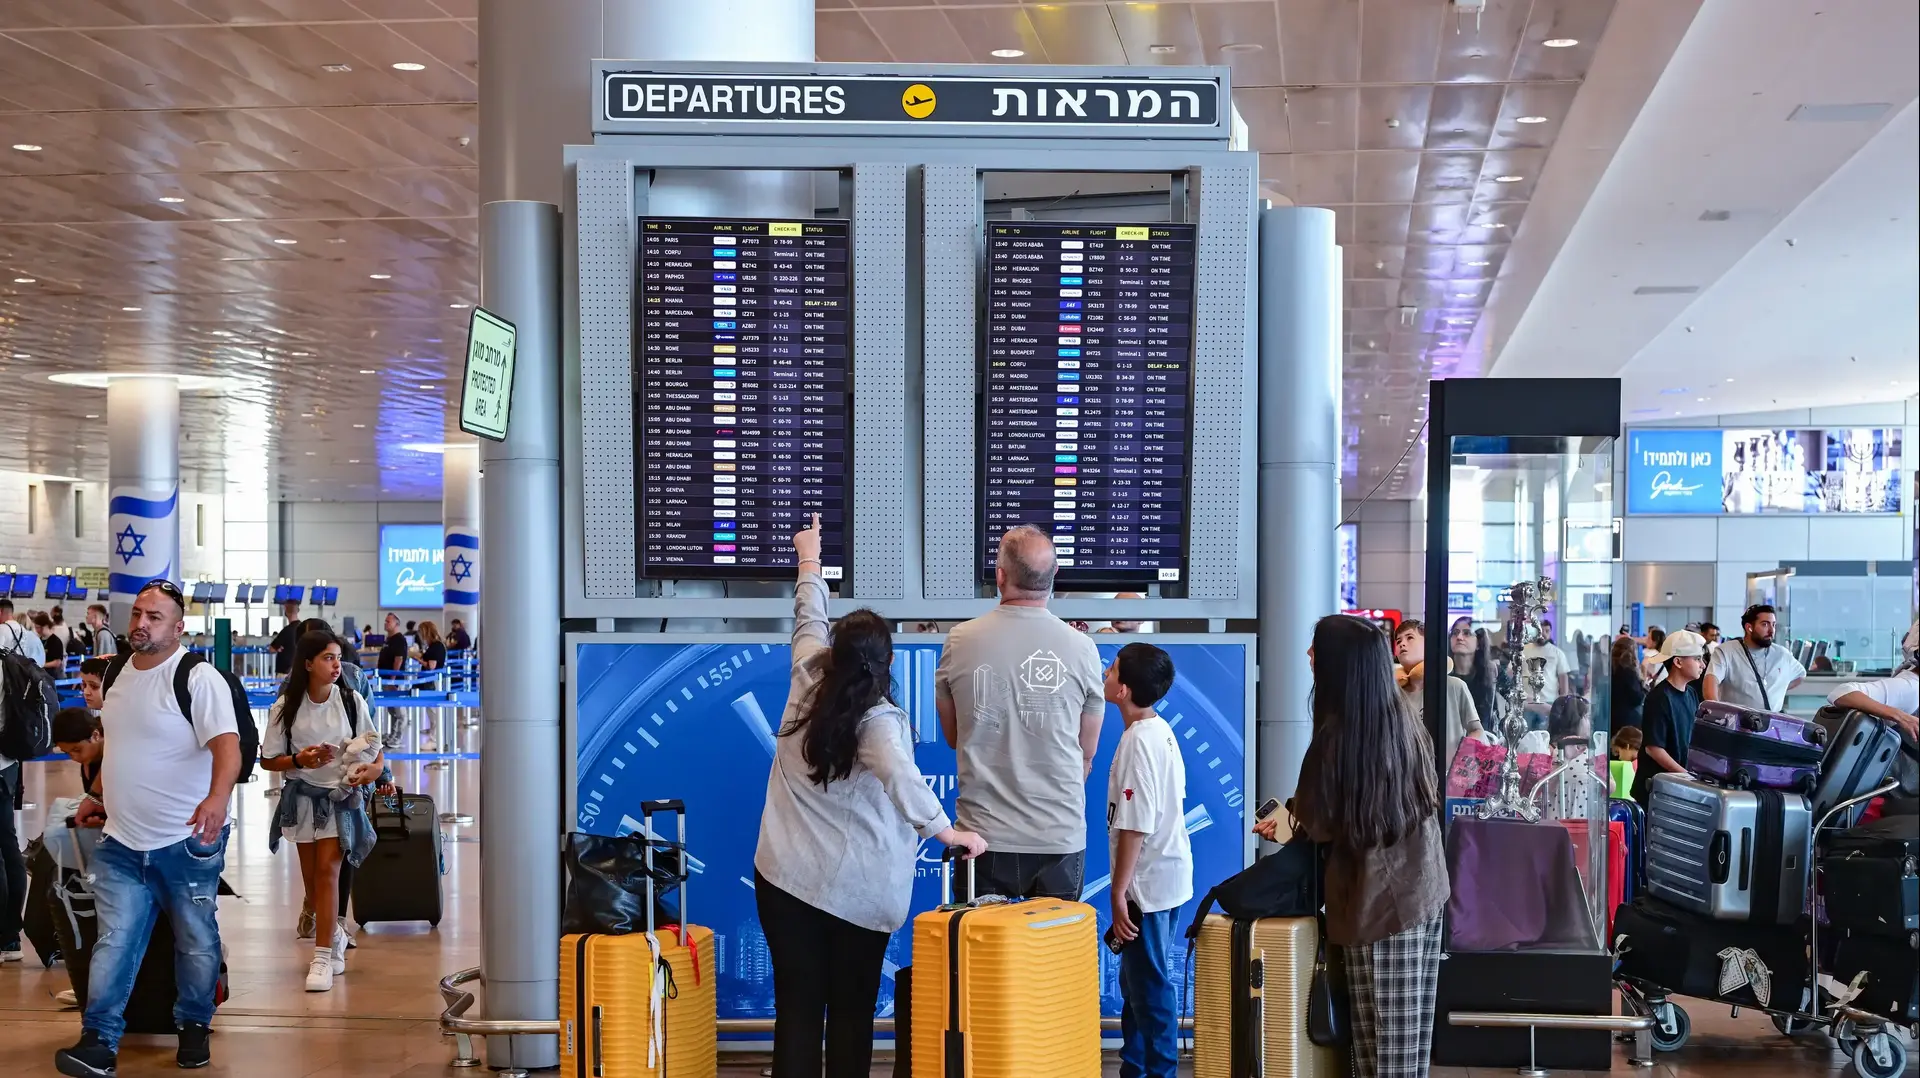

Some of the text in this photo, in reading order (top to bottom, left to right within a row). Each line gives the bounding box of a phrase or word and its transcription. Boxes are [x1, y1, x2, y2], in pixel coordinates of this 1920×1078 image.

[622, 84, 845, 115] DEPARTURES
[993, 87, 1200, 119] המראות
[472, 340, 500, 367] מרחב מוגן
[471, 370, 496, 394] PROTECTED
[474, 398, 486, 416] AREA
[1644, 450, 1711, 468] כאן ולתמיד!
[388, 547, 444, 565] אן ולתמיד!
[709, 662, 733, 686] 55
[1222, 786, 1243, 807] 10
[579, 802, 600, 827] 50
